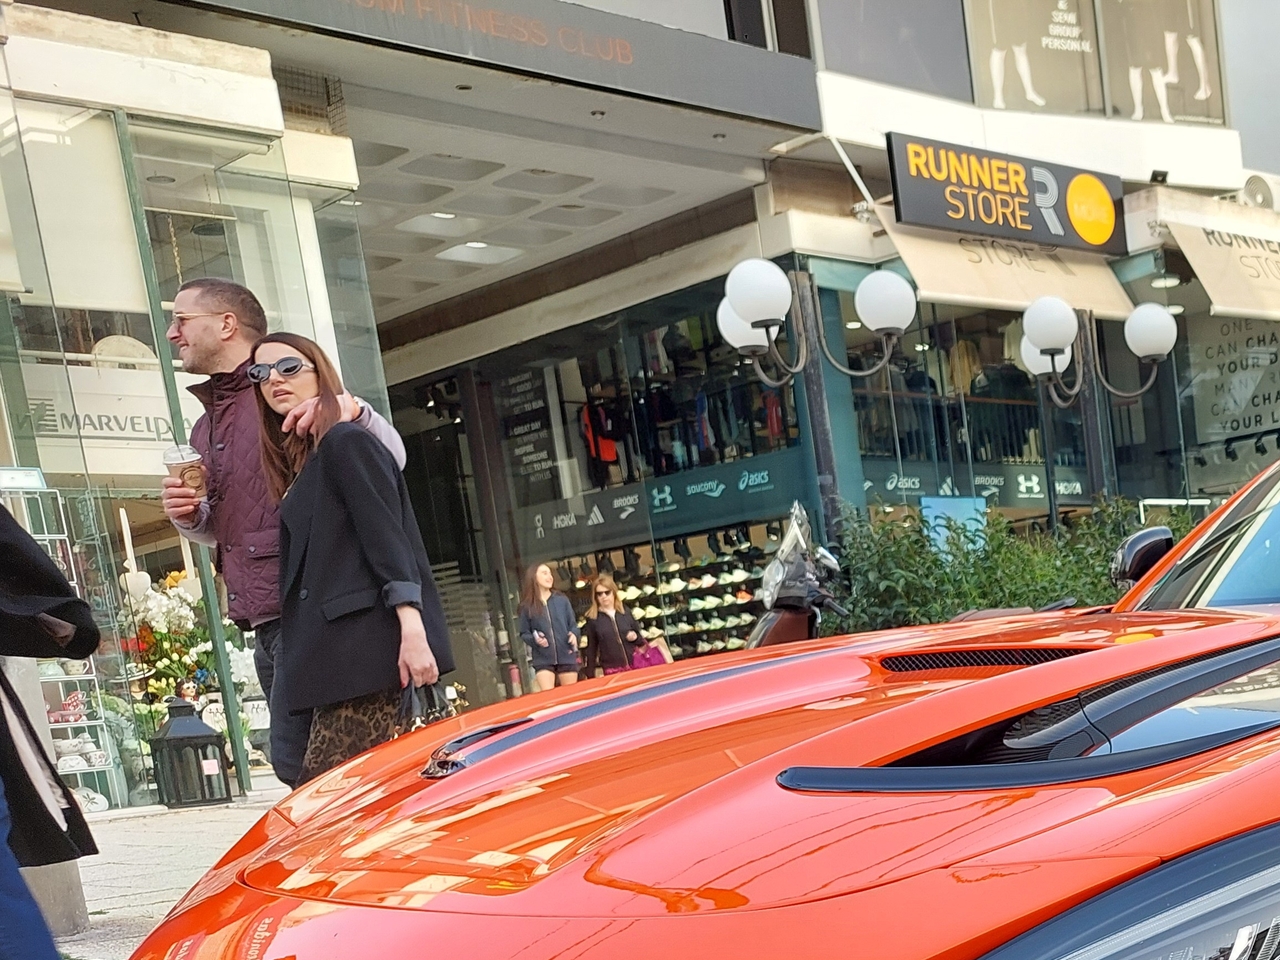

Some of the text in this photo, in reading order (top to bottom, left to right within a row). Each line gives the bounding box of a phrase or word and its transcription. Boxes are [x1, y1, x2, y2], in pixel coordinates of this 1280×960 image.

[558, 26, 634, 65] CLUB
[906, 142, 1029, 196] RUNNER
[944, 185, 1033, 231] STORE
[1220, 318, 1253, 337] ONE
[1205, 341, 1238, 360] CAN
[1217, 356, 1260, 376] YOUR
[1220, 414, 1263, 432] YOUR
[974, 475, 1005, 486] BROOKS
[612, 494, 639, 509] BROOKS
